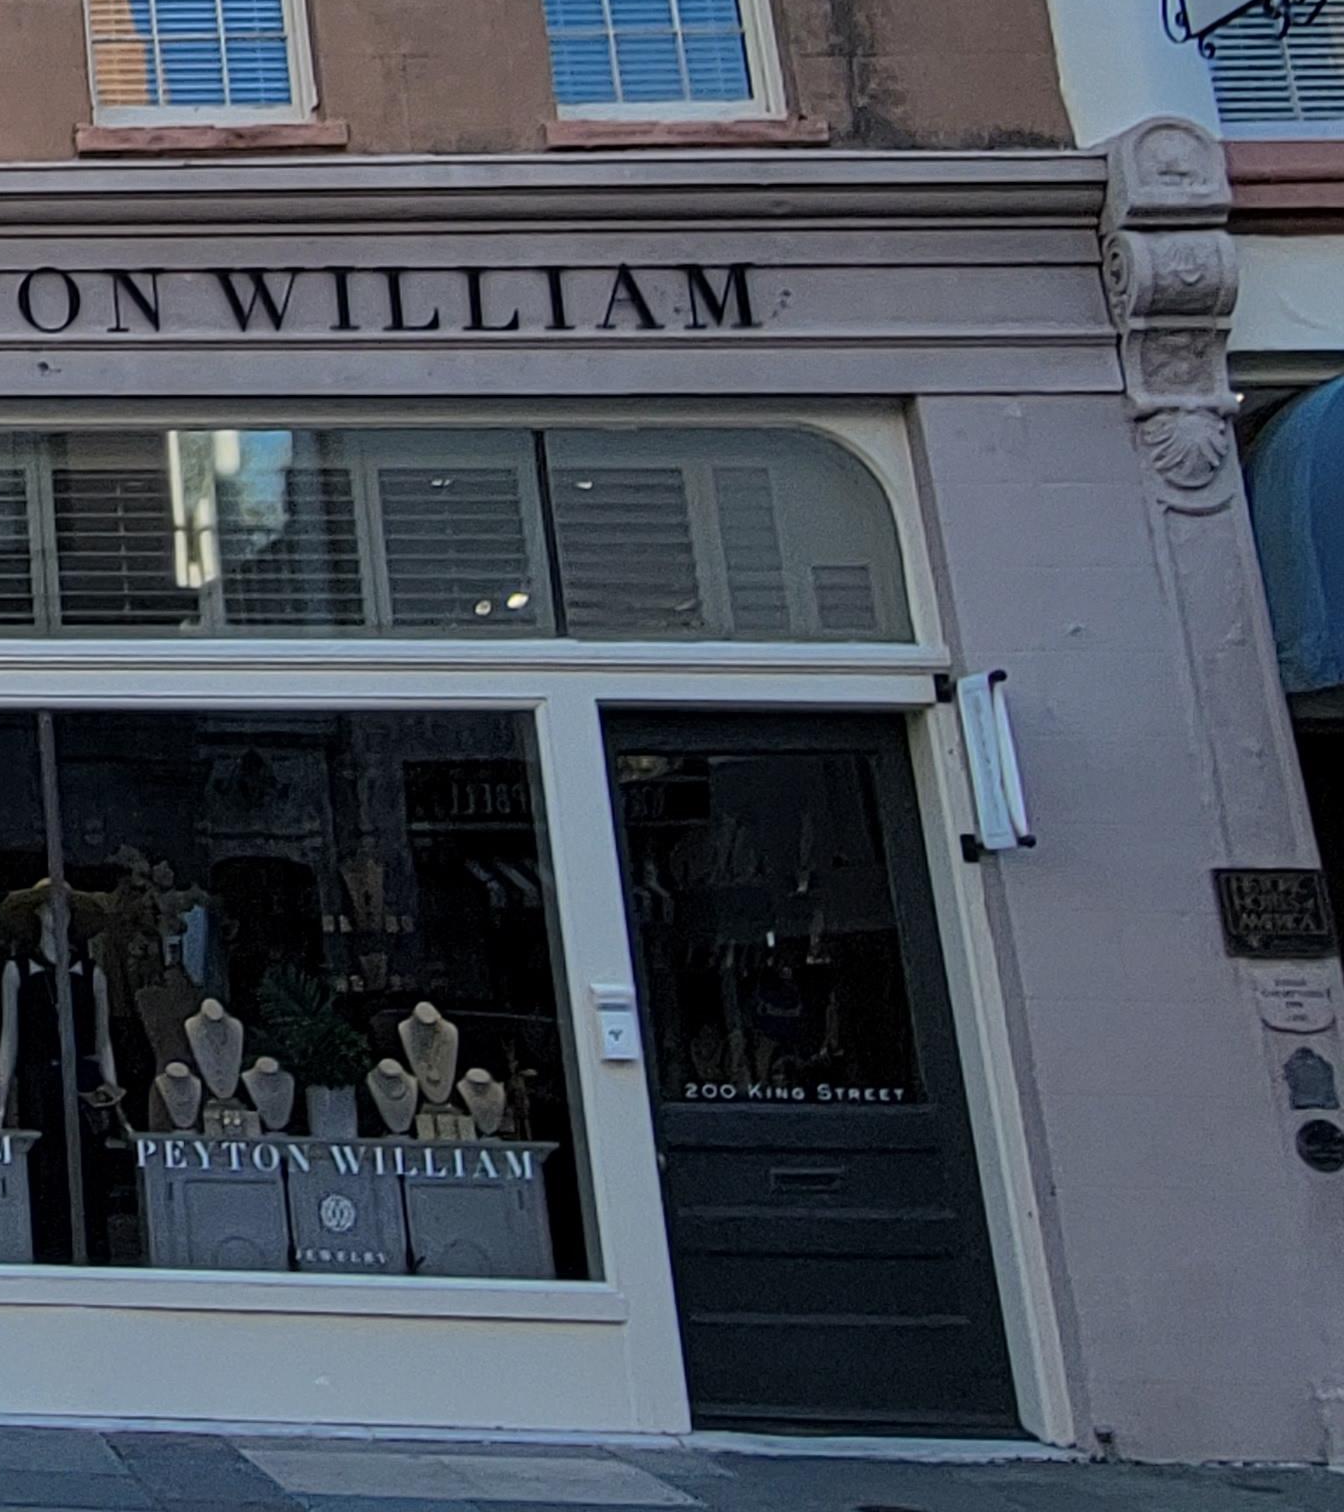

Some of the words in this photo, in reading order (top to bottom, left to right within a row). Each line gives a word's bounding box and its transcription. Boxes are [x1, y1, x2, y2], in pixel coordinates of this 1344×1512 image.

[211, 262, 766, 334] WILLIAM
[683, 1082, 737, 1101] 200
[136, 1139, 311, 1174] PEYTON
[328, 1145, 536, 1181] WILLIAM
